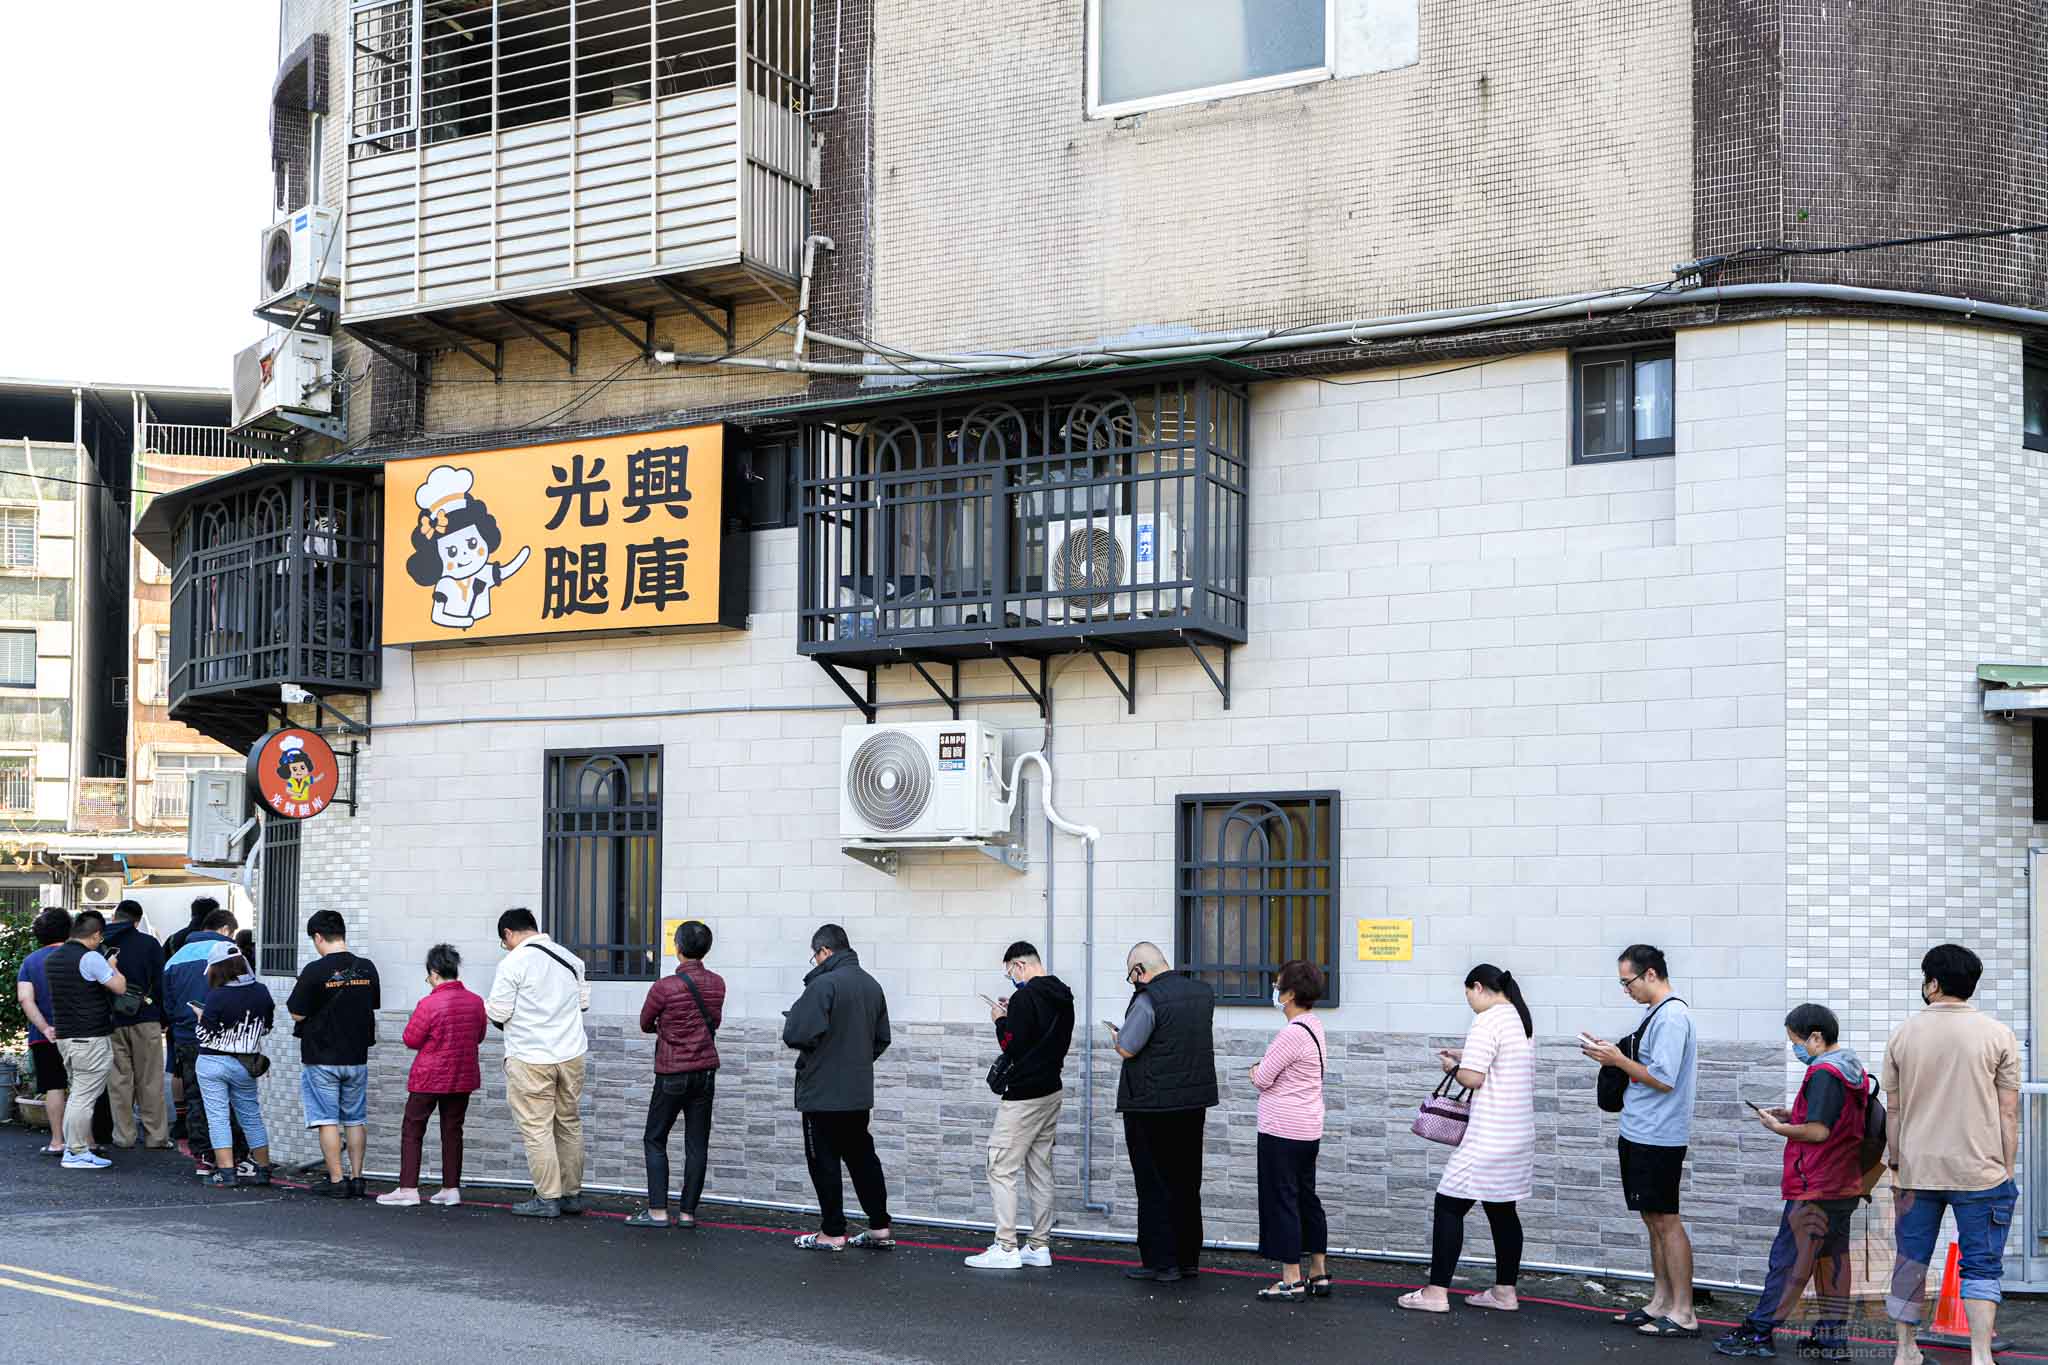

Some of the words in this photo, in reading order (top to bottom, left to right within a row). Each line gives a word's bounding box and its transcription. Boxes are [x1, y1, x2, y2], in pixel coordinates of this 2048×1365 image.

[544, 444, 692, 531] 光興
[541, 536, 690, 620] 腿庫
[940, 735, 965, 745] SAMPO
